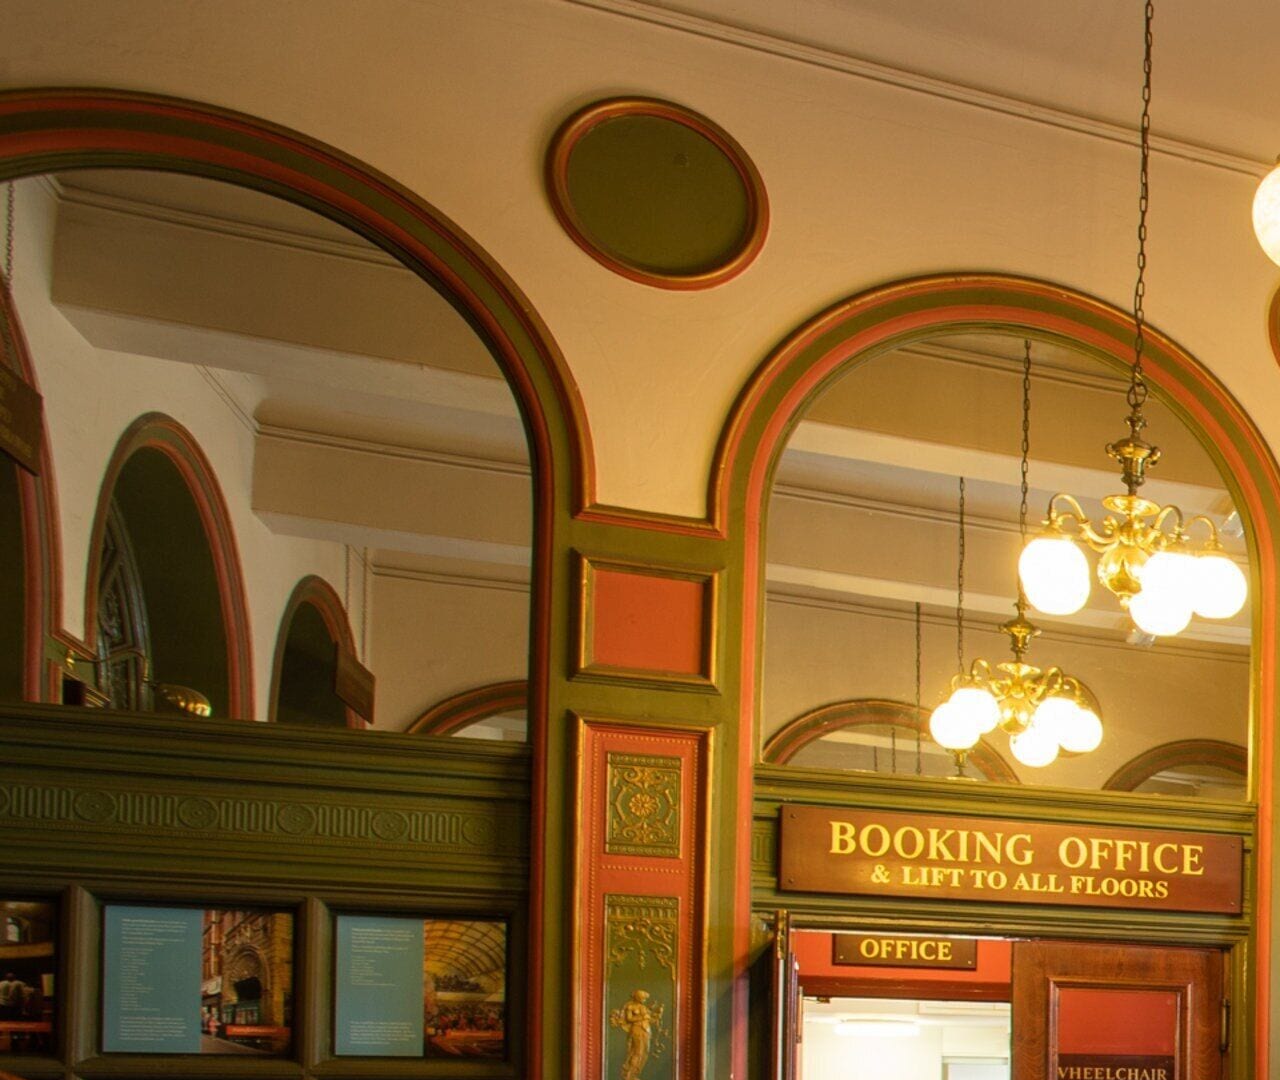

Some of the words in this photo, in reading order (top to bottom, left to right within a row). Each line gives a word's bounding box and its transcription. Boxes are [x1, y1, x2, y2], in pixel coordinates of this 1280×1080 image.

[829, 821, 1033, 865] BOOKING
[1058, 837, 1204, 875] OFFICE
[871, 865, 890, 884] &
[903, 866, 965, 887] LIFT
[971, 869, 1007, 889] TO
[1013, 872, 1064, 893] ALL
[1071, 876, 1169, 898] FLOORS
[860, 939, 952, 960] OFFICE
